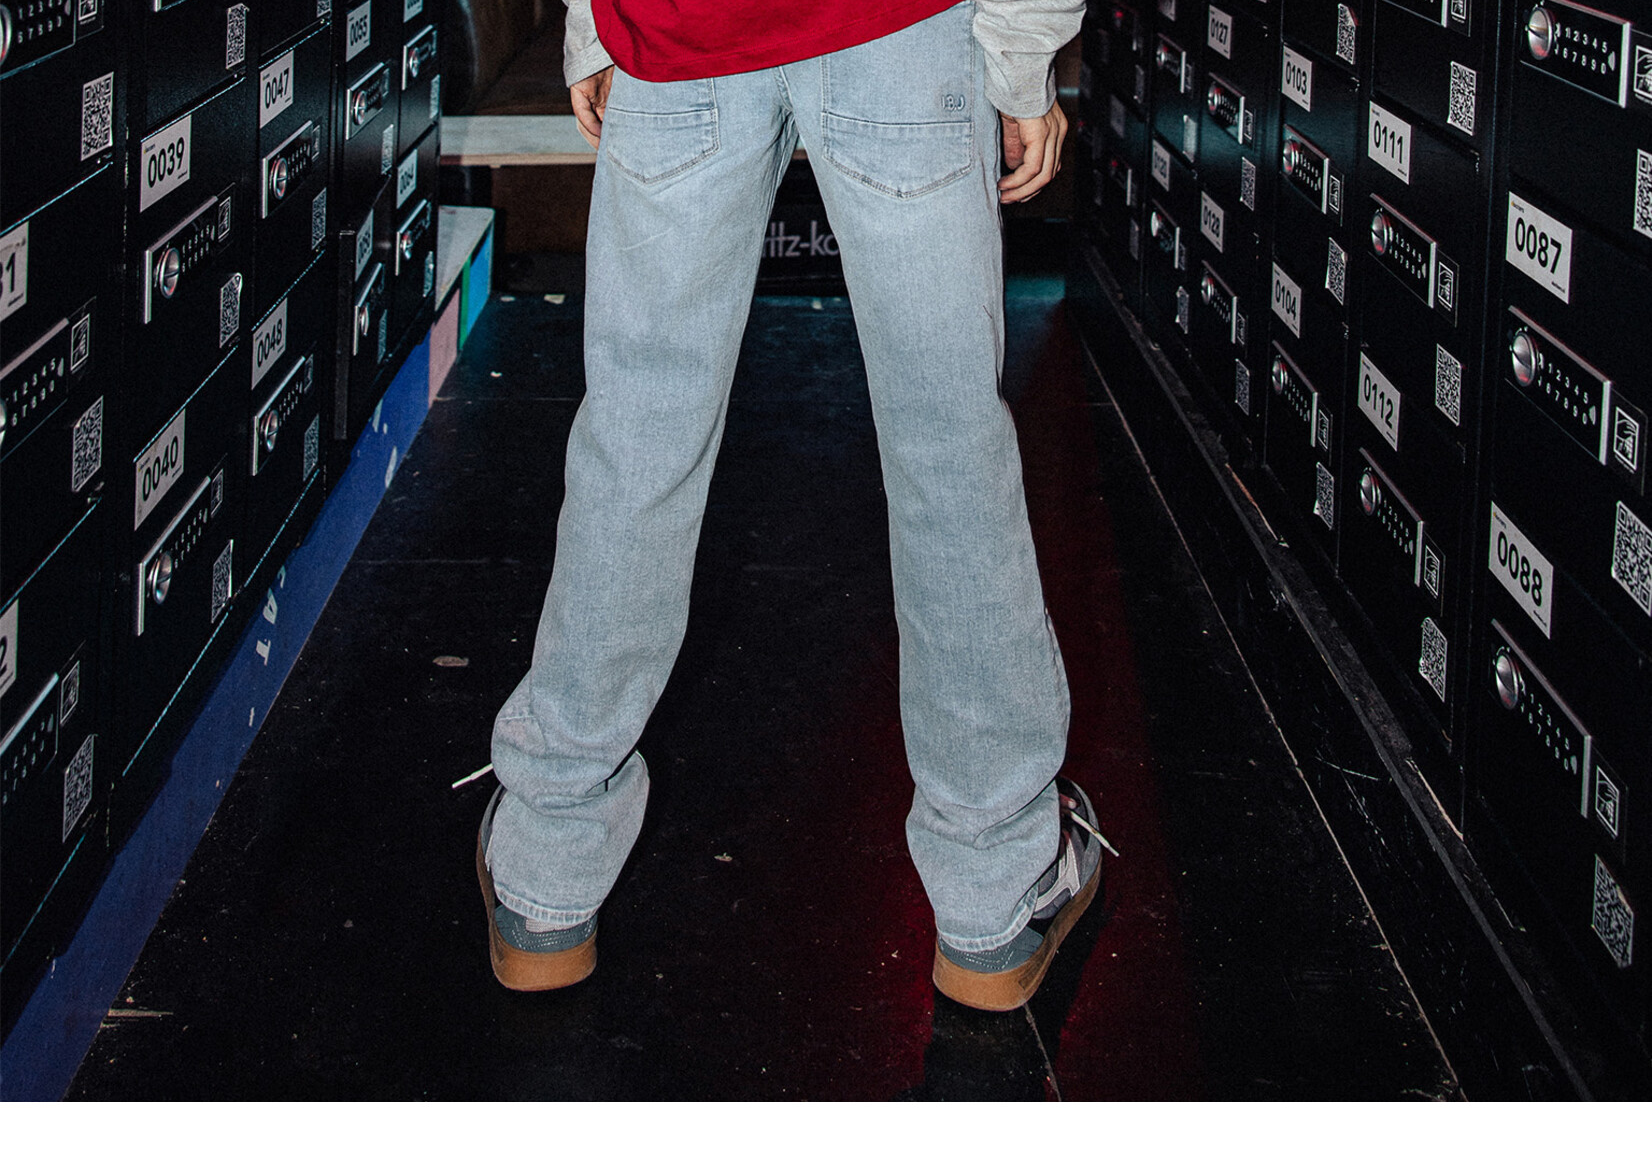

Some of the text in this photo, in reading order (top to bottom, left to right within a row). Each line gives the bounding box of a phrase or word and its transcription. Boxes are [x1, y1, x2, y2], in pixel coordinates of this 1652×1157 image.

[348, 16, 370, 50] 0055
[1210, 17, 1228, 45] 0127
[265, 67, 291, 109] 0047
[1285, 61, 1307, 95] 0103
[147, 135, 186, 188] 0039
[1373, 120, 1403, 165] 0111
[1515, 216, 1562, 274] 0087
[1275, 278, 1297, 321] 0104
[257, 318, 283, 368] 0048
[1363, 373, 1395, 430] 0112
[141, 434, 180, 503] 0040
[1497, 530, 1543, 607] 0088
